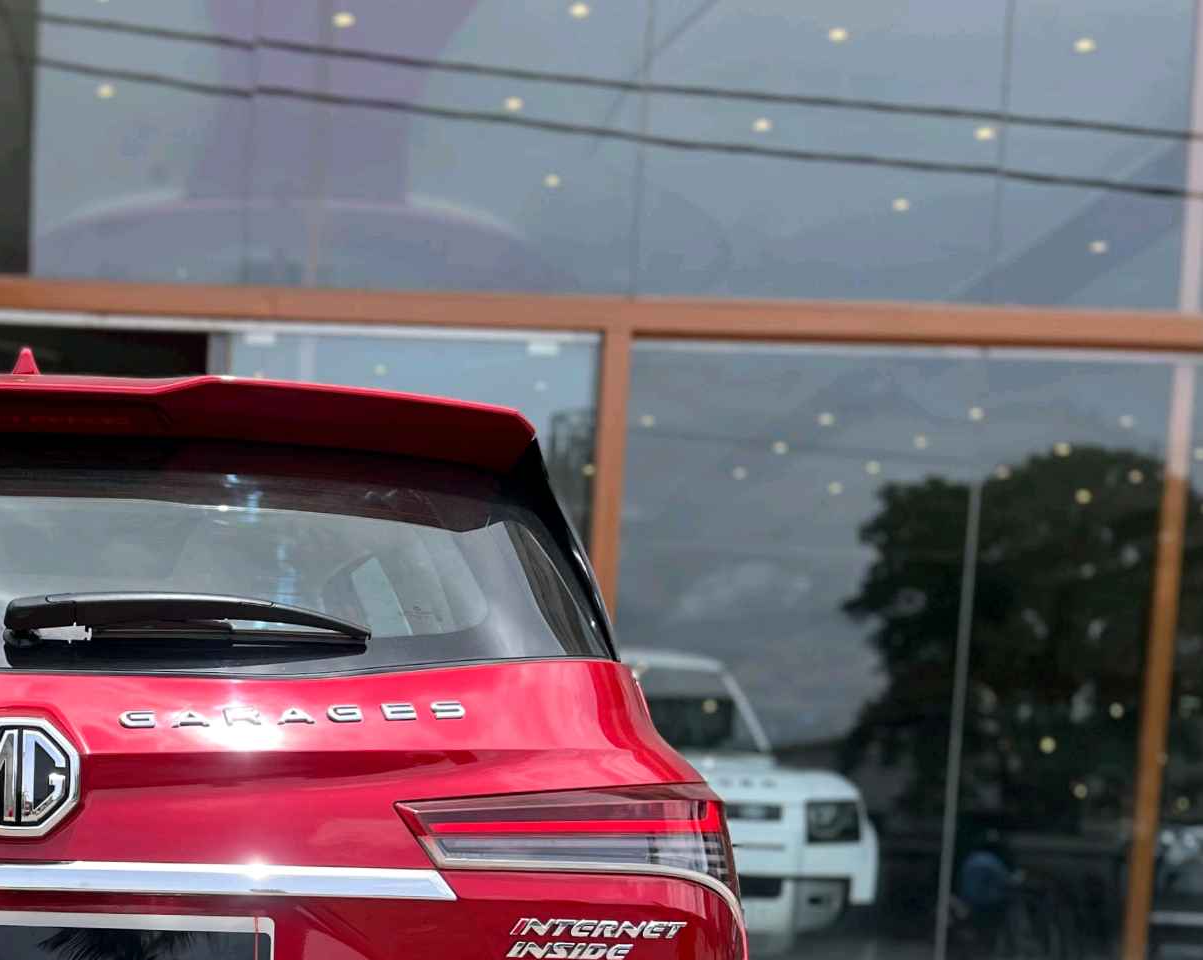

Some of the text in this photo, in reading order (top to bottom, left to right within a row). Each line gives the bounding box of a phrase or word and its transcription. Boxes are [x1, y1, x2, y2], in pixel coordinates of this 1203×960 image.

[119, 700, 467, 729] GARAGES
[509, 917, 688, 939] INTERNET
[505, 941, 635, 960] INSIDE
